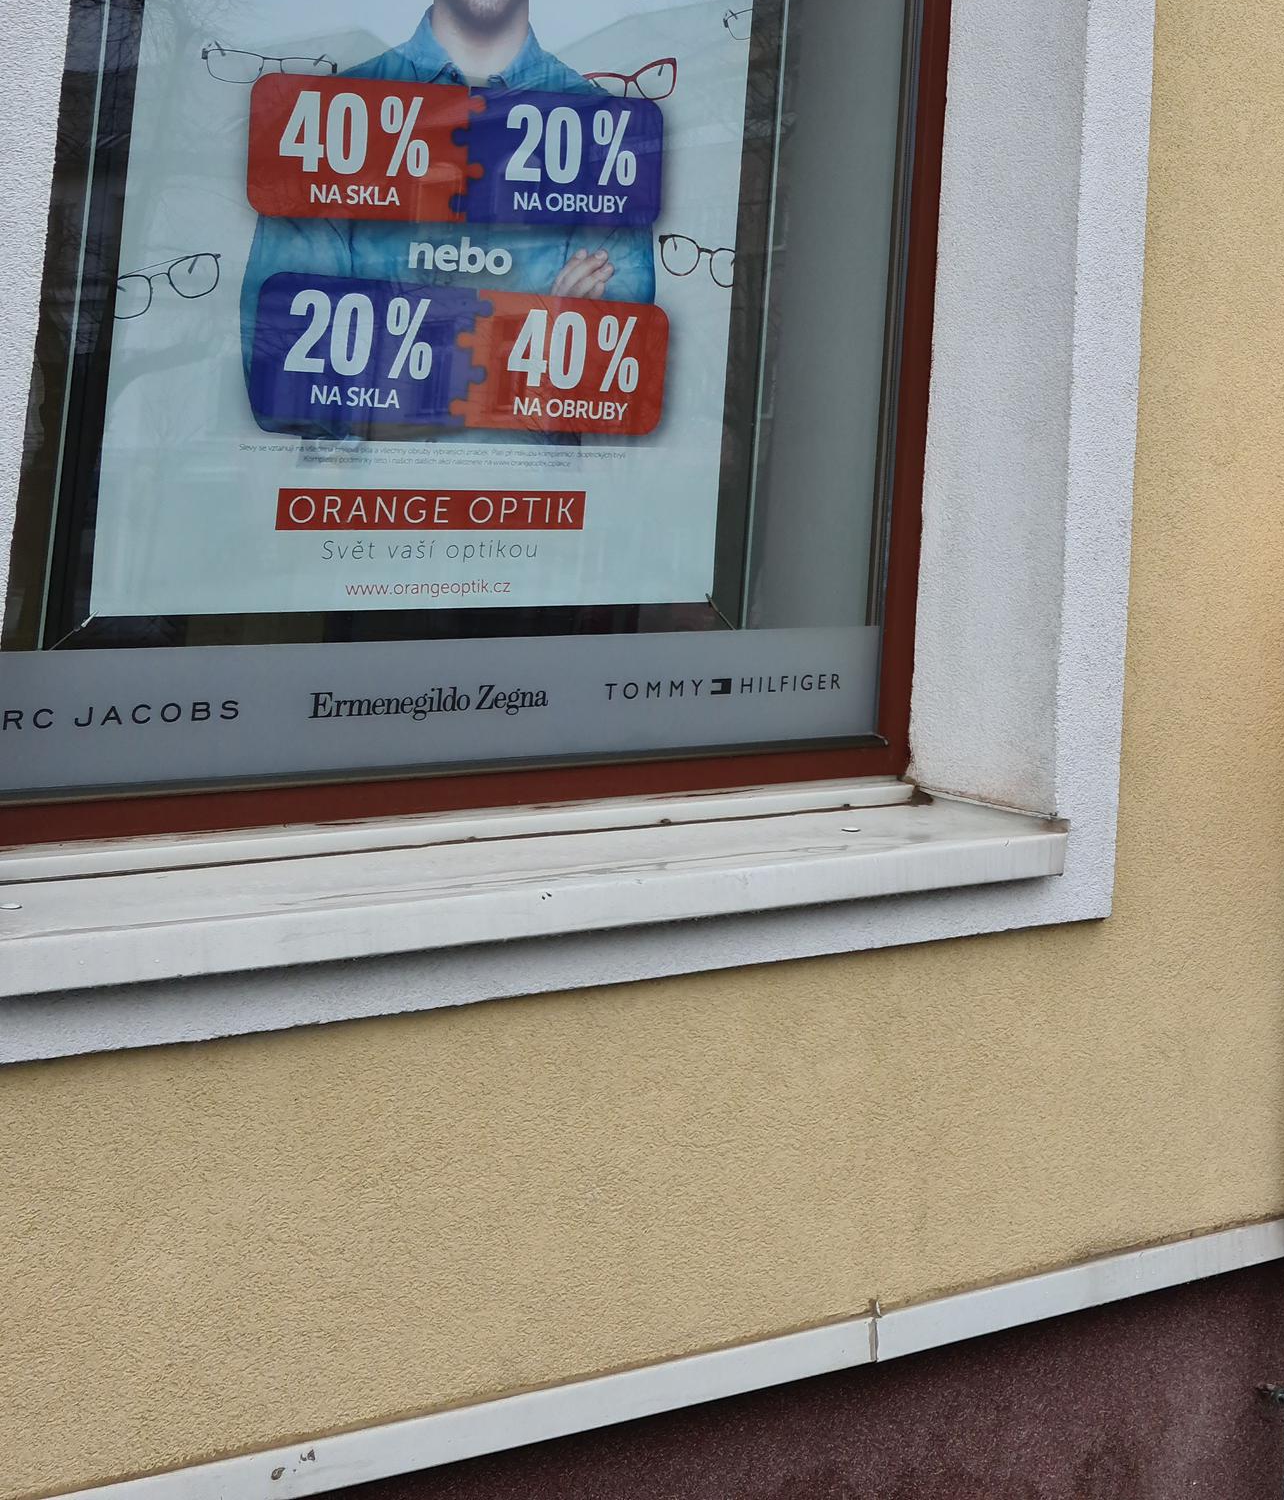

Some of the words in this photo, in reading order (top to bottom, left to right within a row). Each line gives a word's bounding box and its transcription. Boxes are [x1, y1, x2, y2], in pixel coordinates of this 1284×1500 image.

[309, 183, 341, 204] NA
[346, 185, 400, 206] SKLA
[513, 192, 541, 211] NA
[546, 193, 627, 214] OBRUBY
[407, 237, 512, 275] nebo
[310, 385, 342, 406] NA
[346, 388, 400, 409] SKLA
[513, 398, 541, 417] NA
[546, 399, 627, 420] OBRUBY
[288, 496, 449, 524] ORANGE
[468, 496, 575, 525] OPTIK
[322, 540, 375, 561] Svět
[388, 540, 437, 560] vaší
[446, 540, 538, 564] optikou
[345, 580, 511, 598] www.orangeoptik.cz
[605, 680, 703, 700] TOMMY
[740, 674, 841, 694] HILFIGER
[308, 688, 471, 720] Ermenegildo
[475, 684, 548, 714] Zegna
[2, 708, 54, 730] RC
[74, 700, 239, 728] JACOBS
